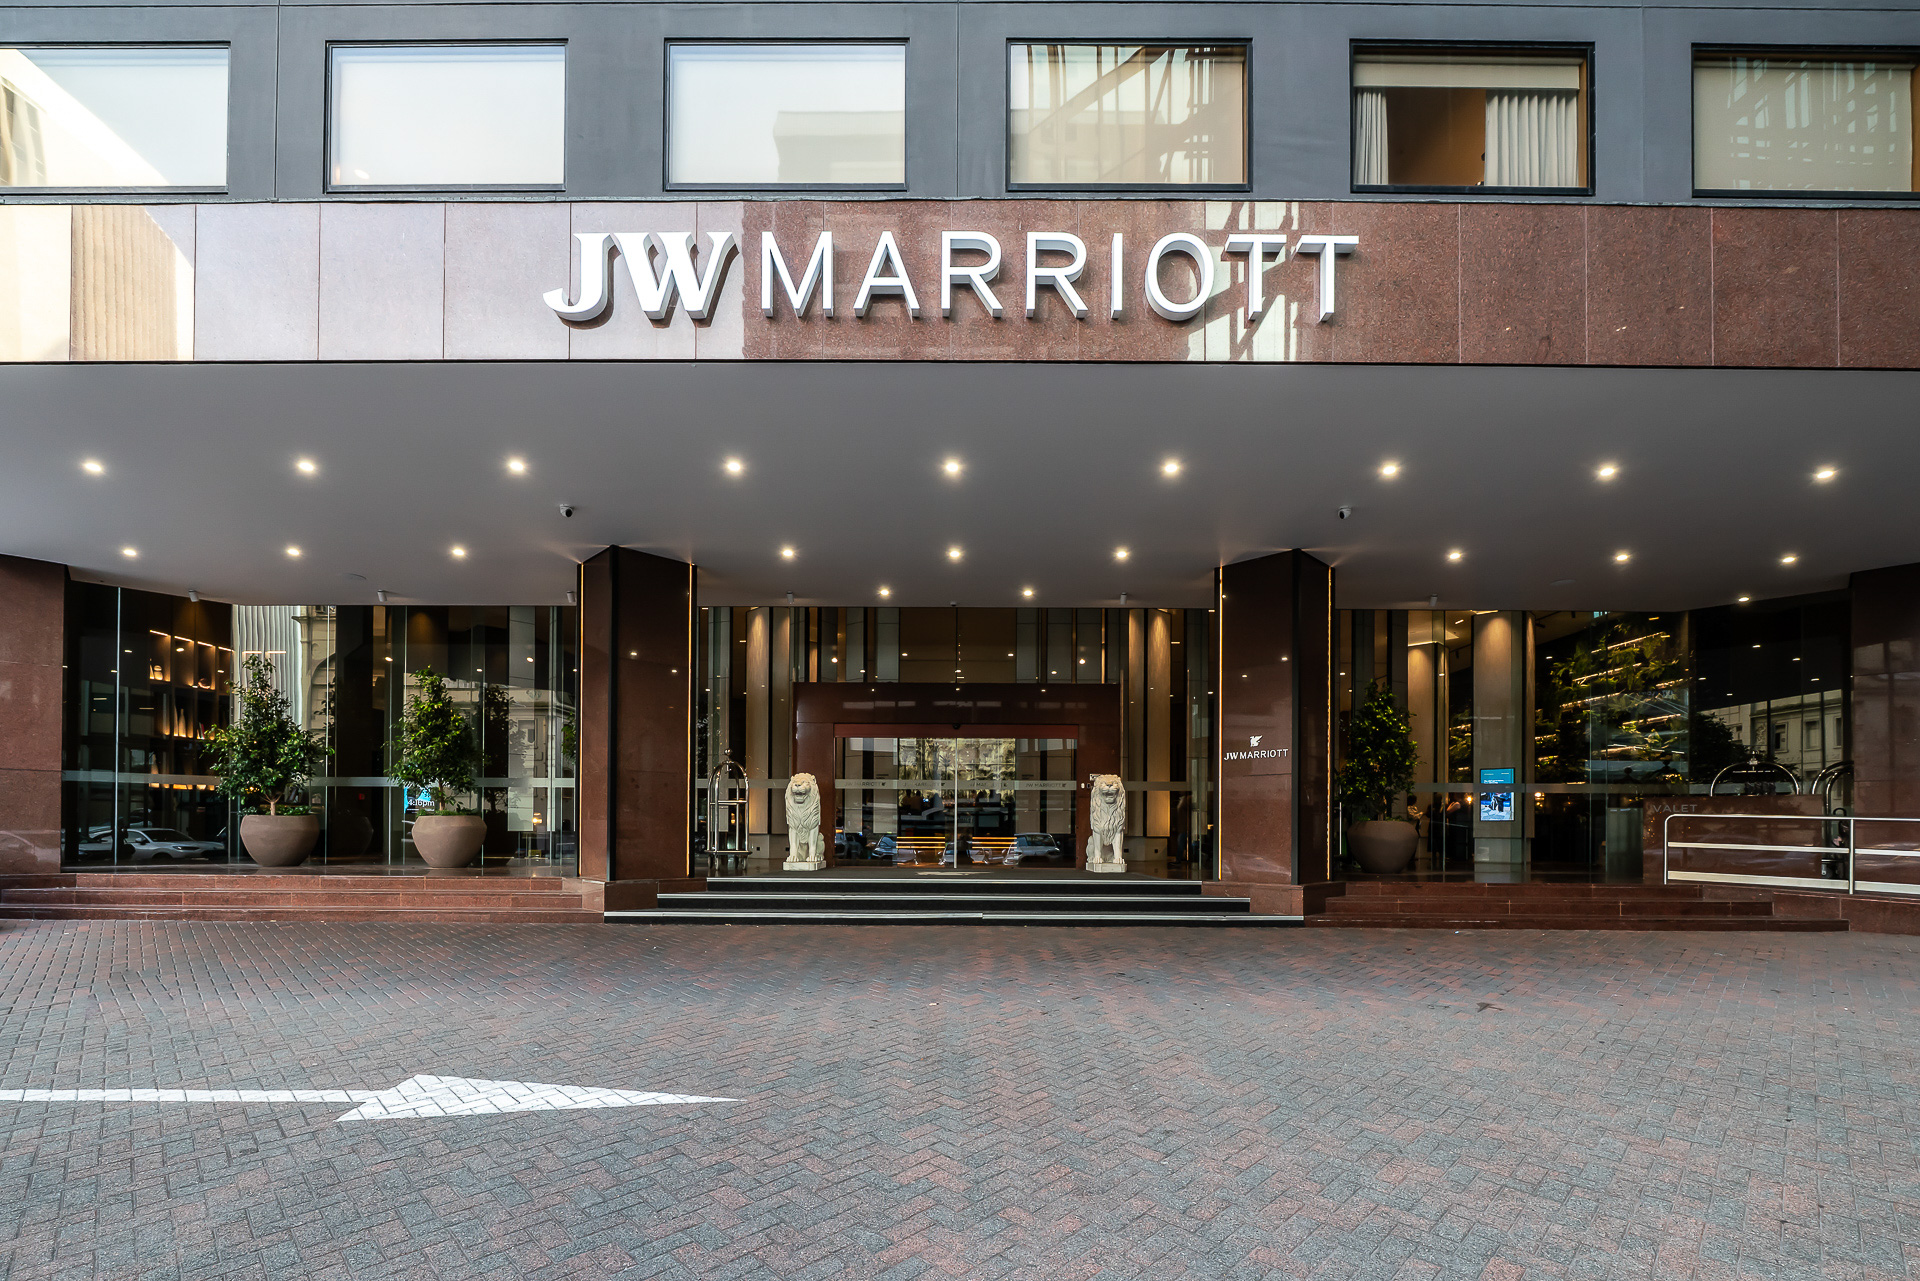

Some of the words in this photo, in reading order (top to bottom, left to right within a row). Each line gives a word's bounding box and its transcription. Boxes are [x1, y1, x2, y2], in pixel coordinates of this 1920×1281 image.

[761, 230, 1359, 322] MARRIOTT
[1239, 748, 1289, 760] MARRIOTT
[1653, 804, 1698, 813] VALET
